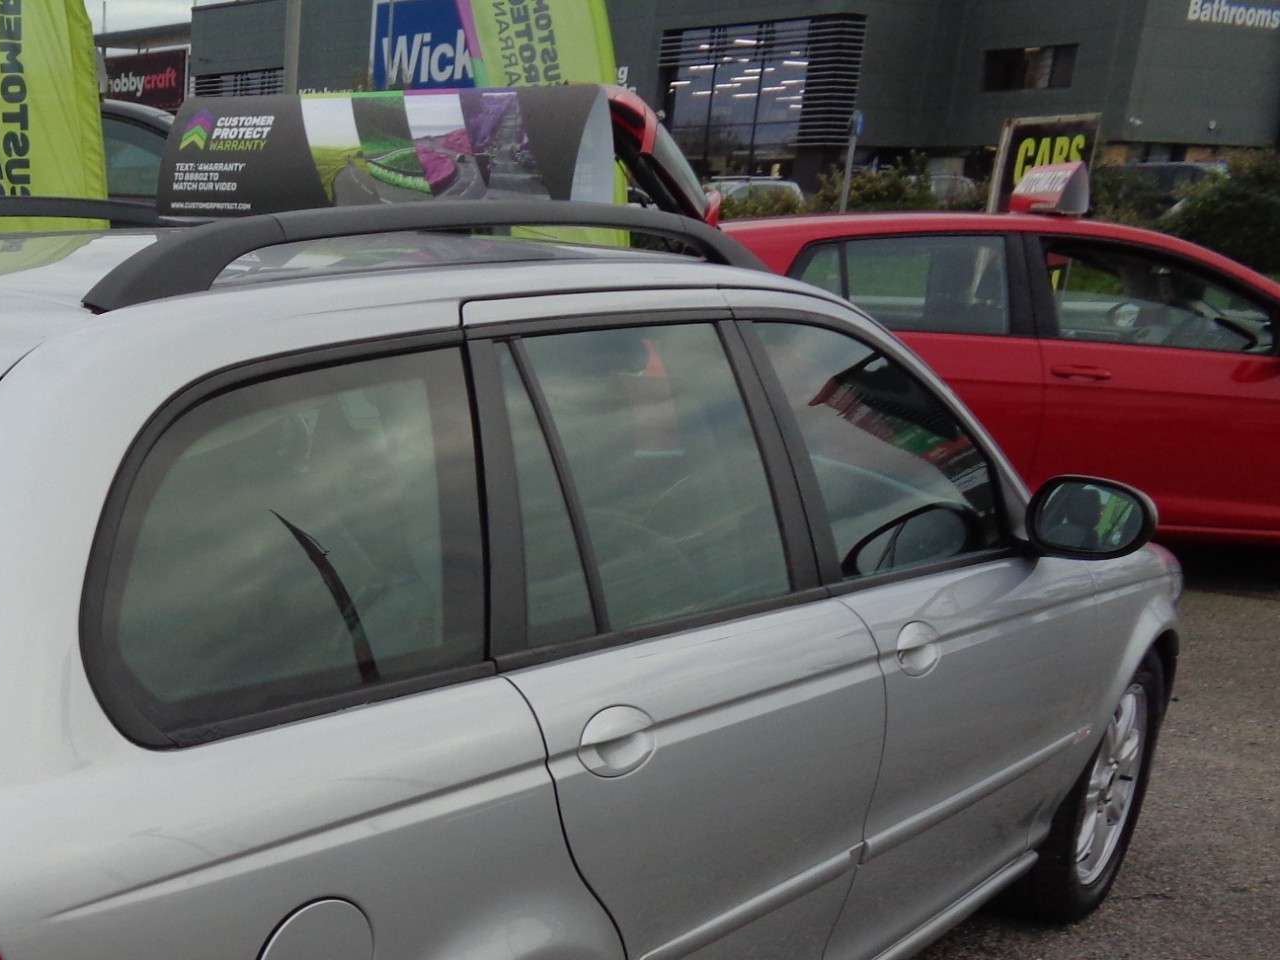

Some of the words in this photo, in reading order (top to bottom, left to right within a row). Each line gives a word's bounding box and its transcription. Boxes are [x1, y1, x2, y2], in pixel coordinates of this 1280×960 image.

[1187, 0, 1280, 29] Bathrooms
[217, 116, 275, 127] CUSTOMER
[212, 127, 272, 140] PROTECT
[209, 140, 267, 151] WARRANTY
[176, 163, 196, 172] TEXT:
[210, 173, 219, 181] TO
[173, 182, 198, 191] WATCH
[199, 182, 214, 191] OUR
[215, 182, 238, 191] VIDEO
